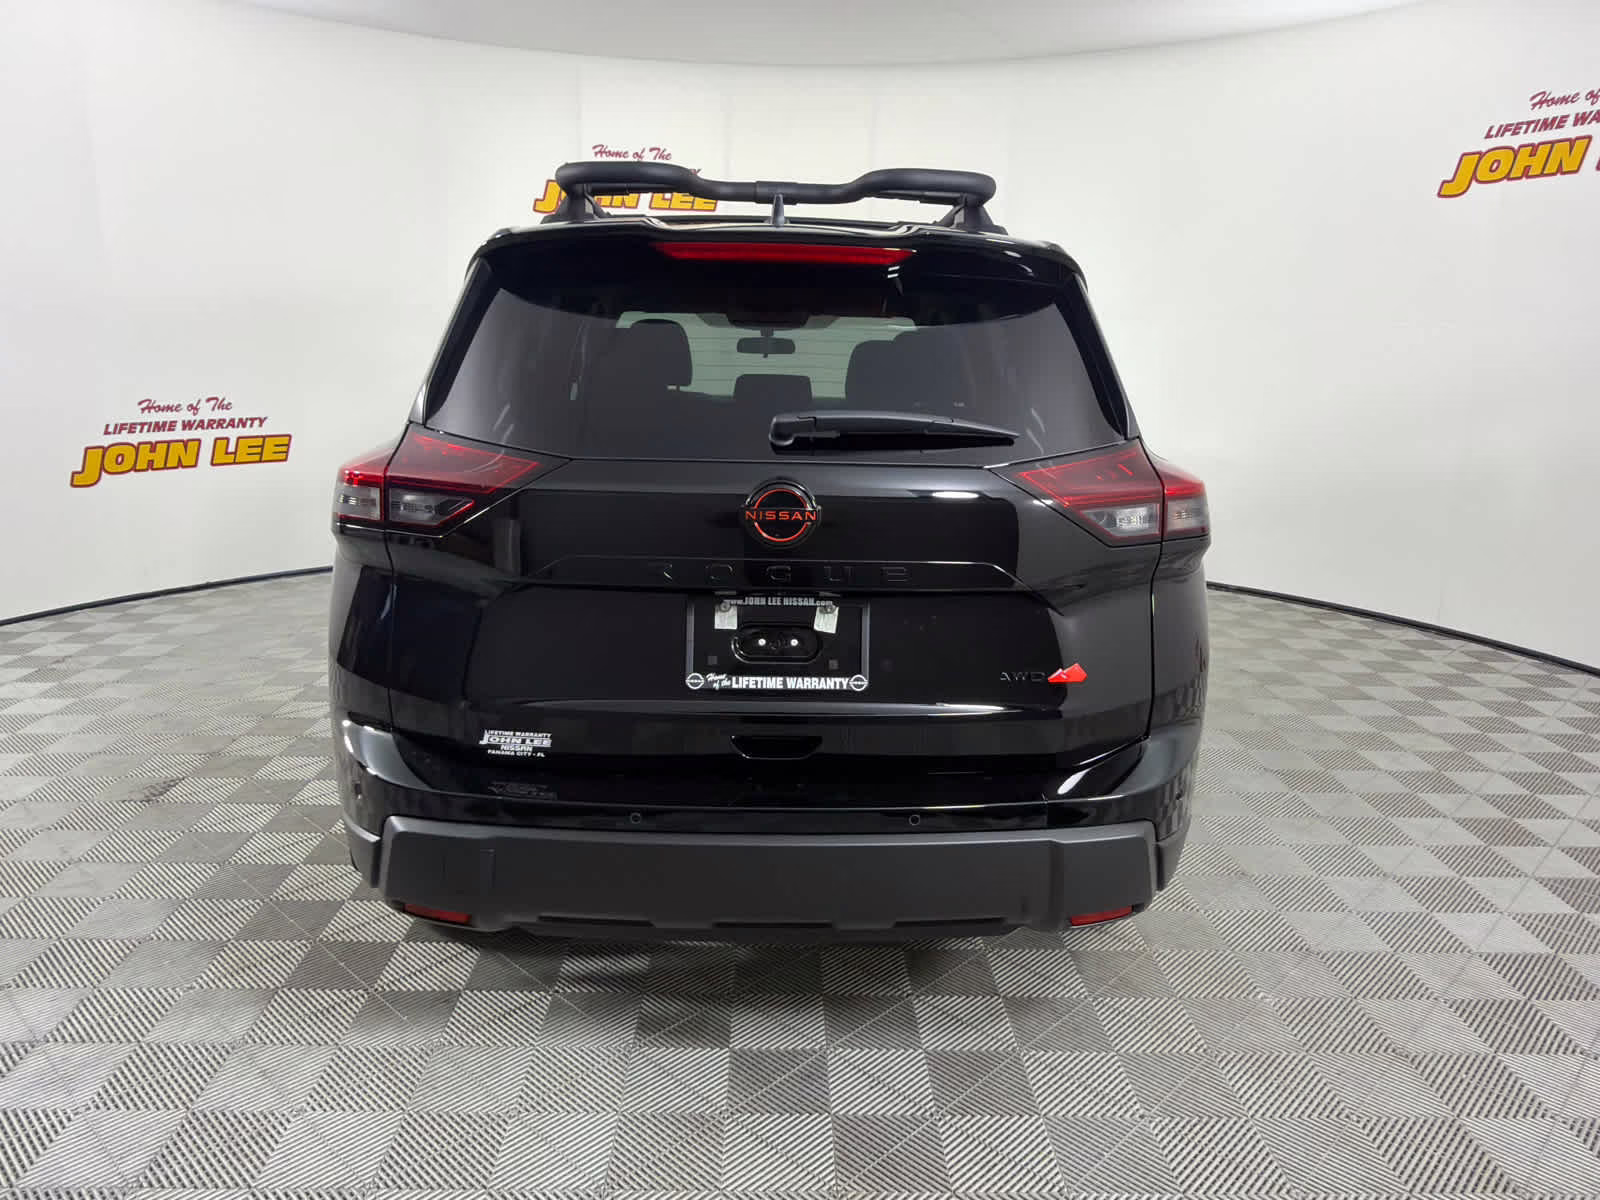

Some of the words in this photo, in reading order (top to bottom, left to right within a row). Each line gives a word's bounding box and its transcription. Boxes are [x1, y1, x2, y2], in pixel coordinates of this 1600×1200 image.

[1529, 91, 1580, 111] Home
[1484, 114, 1570, 139] LIFETIME
[592, 144, 629, 159] Home
[632, 148, 645, 161] of
[649, 147, 672, 160] The
[1437, 134, 1593, 199] JOHN
[137, 398, 183, 414] Home
[186, 399, 200, 416] of
[205, 397, 233, 412] The
[103, 420, 178, 435] LIFETIME
[181, 417, 268, 431] WARRANTY
[70, 439, 202, 488] JOHN
[210, 434, 292, 466] LEE
[745, 510, 818, 521] NISSAN
[732, 676, 784, 689] LIFETIME
[786, 677, 850, 689] WARRANTY
